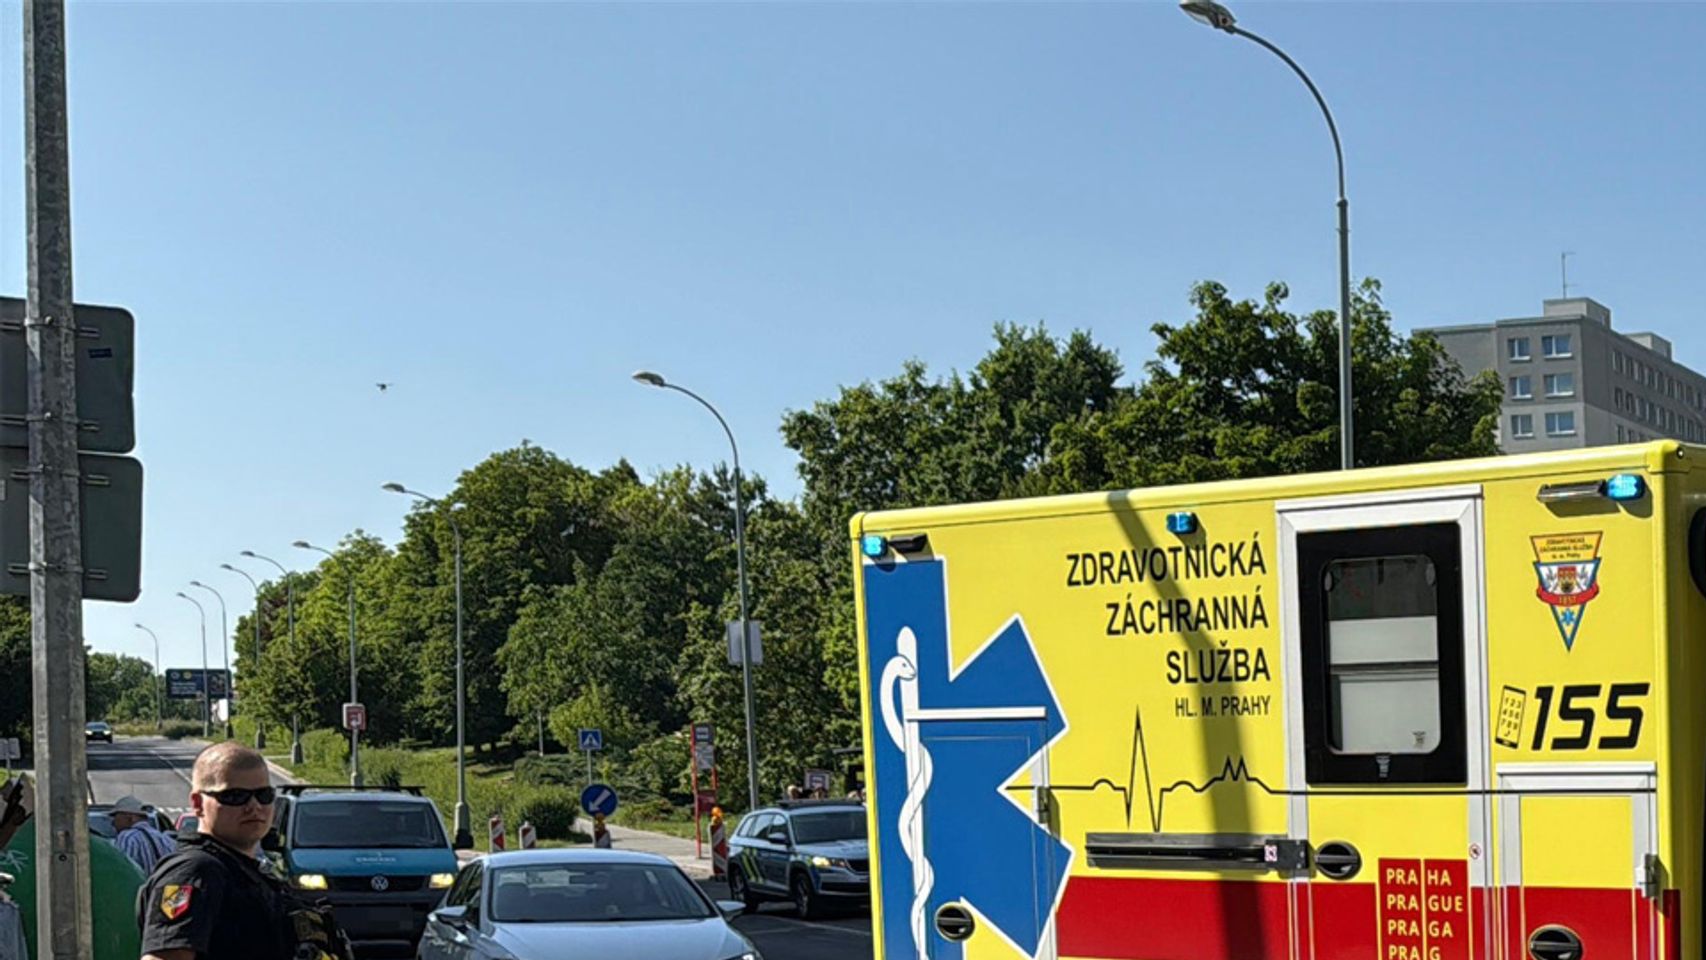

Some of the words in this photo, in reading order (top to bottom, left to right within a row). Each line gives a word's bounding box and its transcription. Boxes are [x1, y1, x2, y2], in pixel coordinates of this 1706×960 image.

[1066, 531, 1267, 587] ZDRAVOTNICKÁ
[1105, 585, 1269, 636] ZÁCHRANNÁ
[1166, 640, 1271, 684] SLUŽBA
[1175, 698, 1198, 717] HL.
[1202, 697, 1217, 716] M.
[1221, 695, 1271, 716] PRAHY
[1531, 682, 1651, 751] 155
[1386, 868, 1419, 885] PRA
[1427, 869, 1452, 886] HA
[1387, 894, 1420, 911] PRA
[1428, 895, 1463, 912] GUE
[1388, 919, 1420, 936] PRA
[1428, 920, 1454, 938] GA
